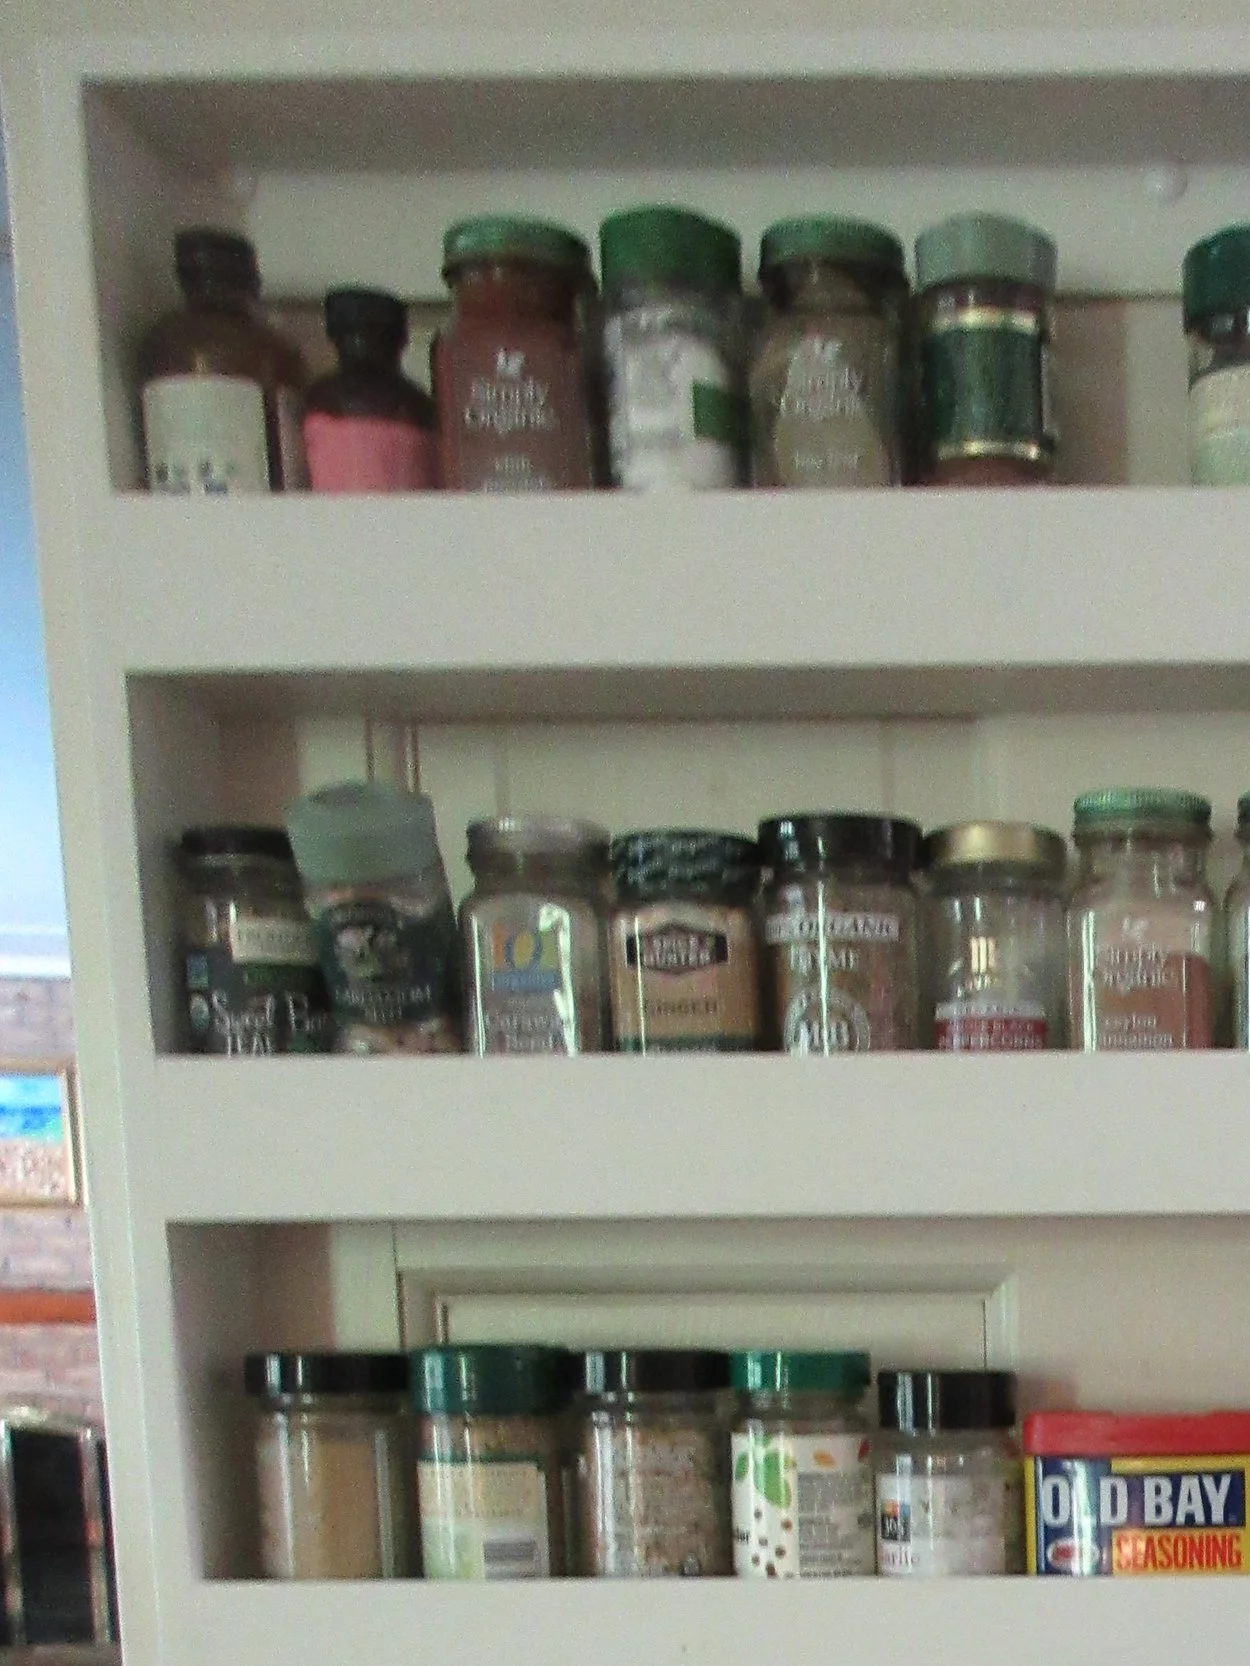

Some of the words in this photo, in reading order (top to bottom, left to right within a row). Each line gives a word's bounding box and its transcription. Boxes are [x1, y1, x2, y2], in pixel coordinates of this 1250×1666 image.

[1041, 1474, 1128, 1528] OD
[1143, 1473, 1232, 1526] BAY
[1116, 1533, 1243, 1572] SEASONING
